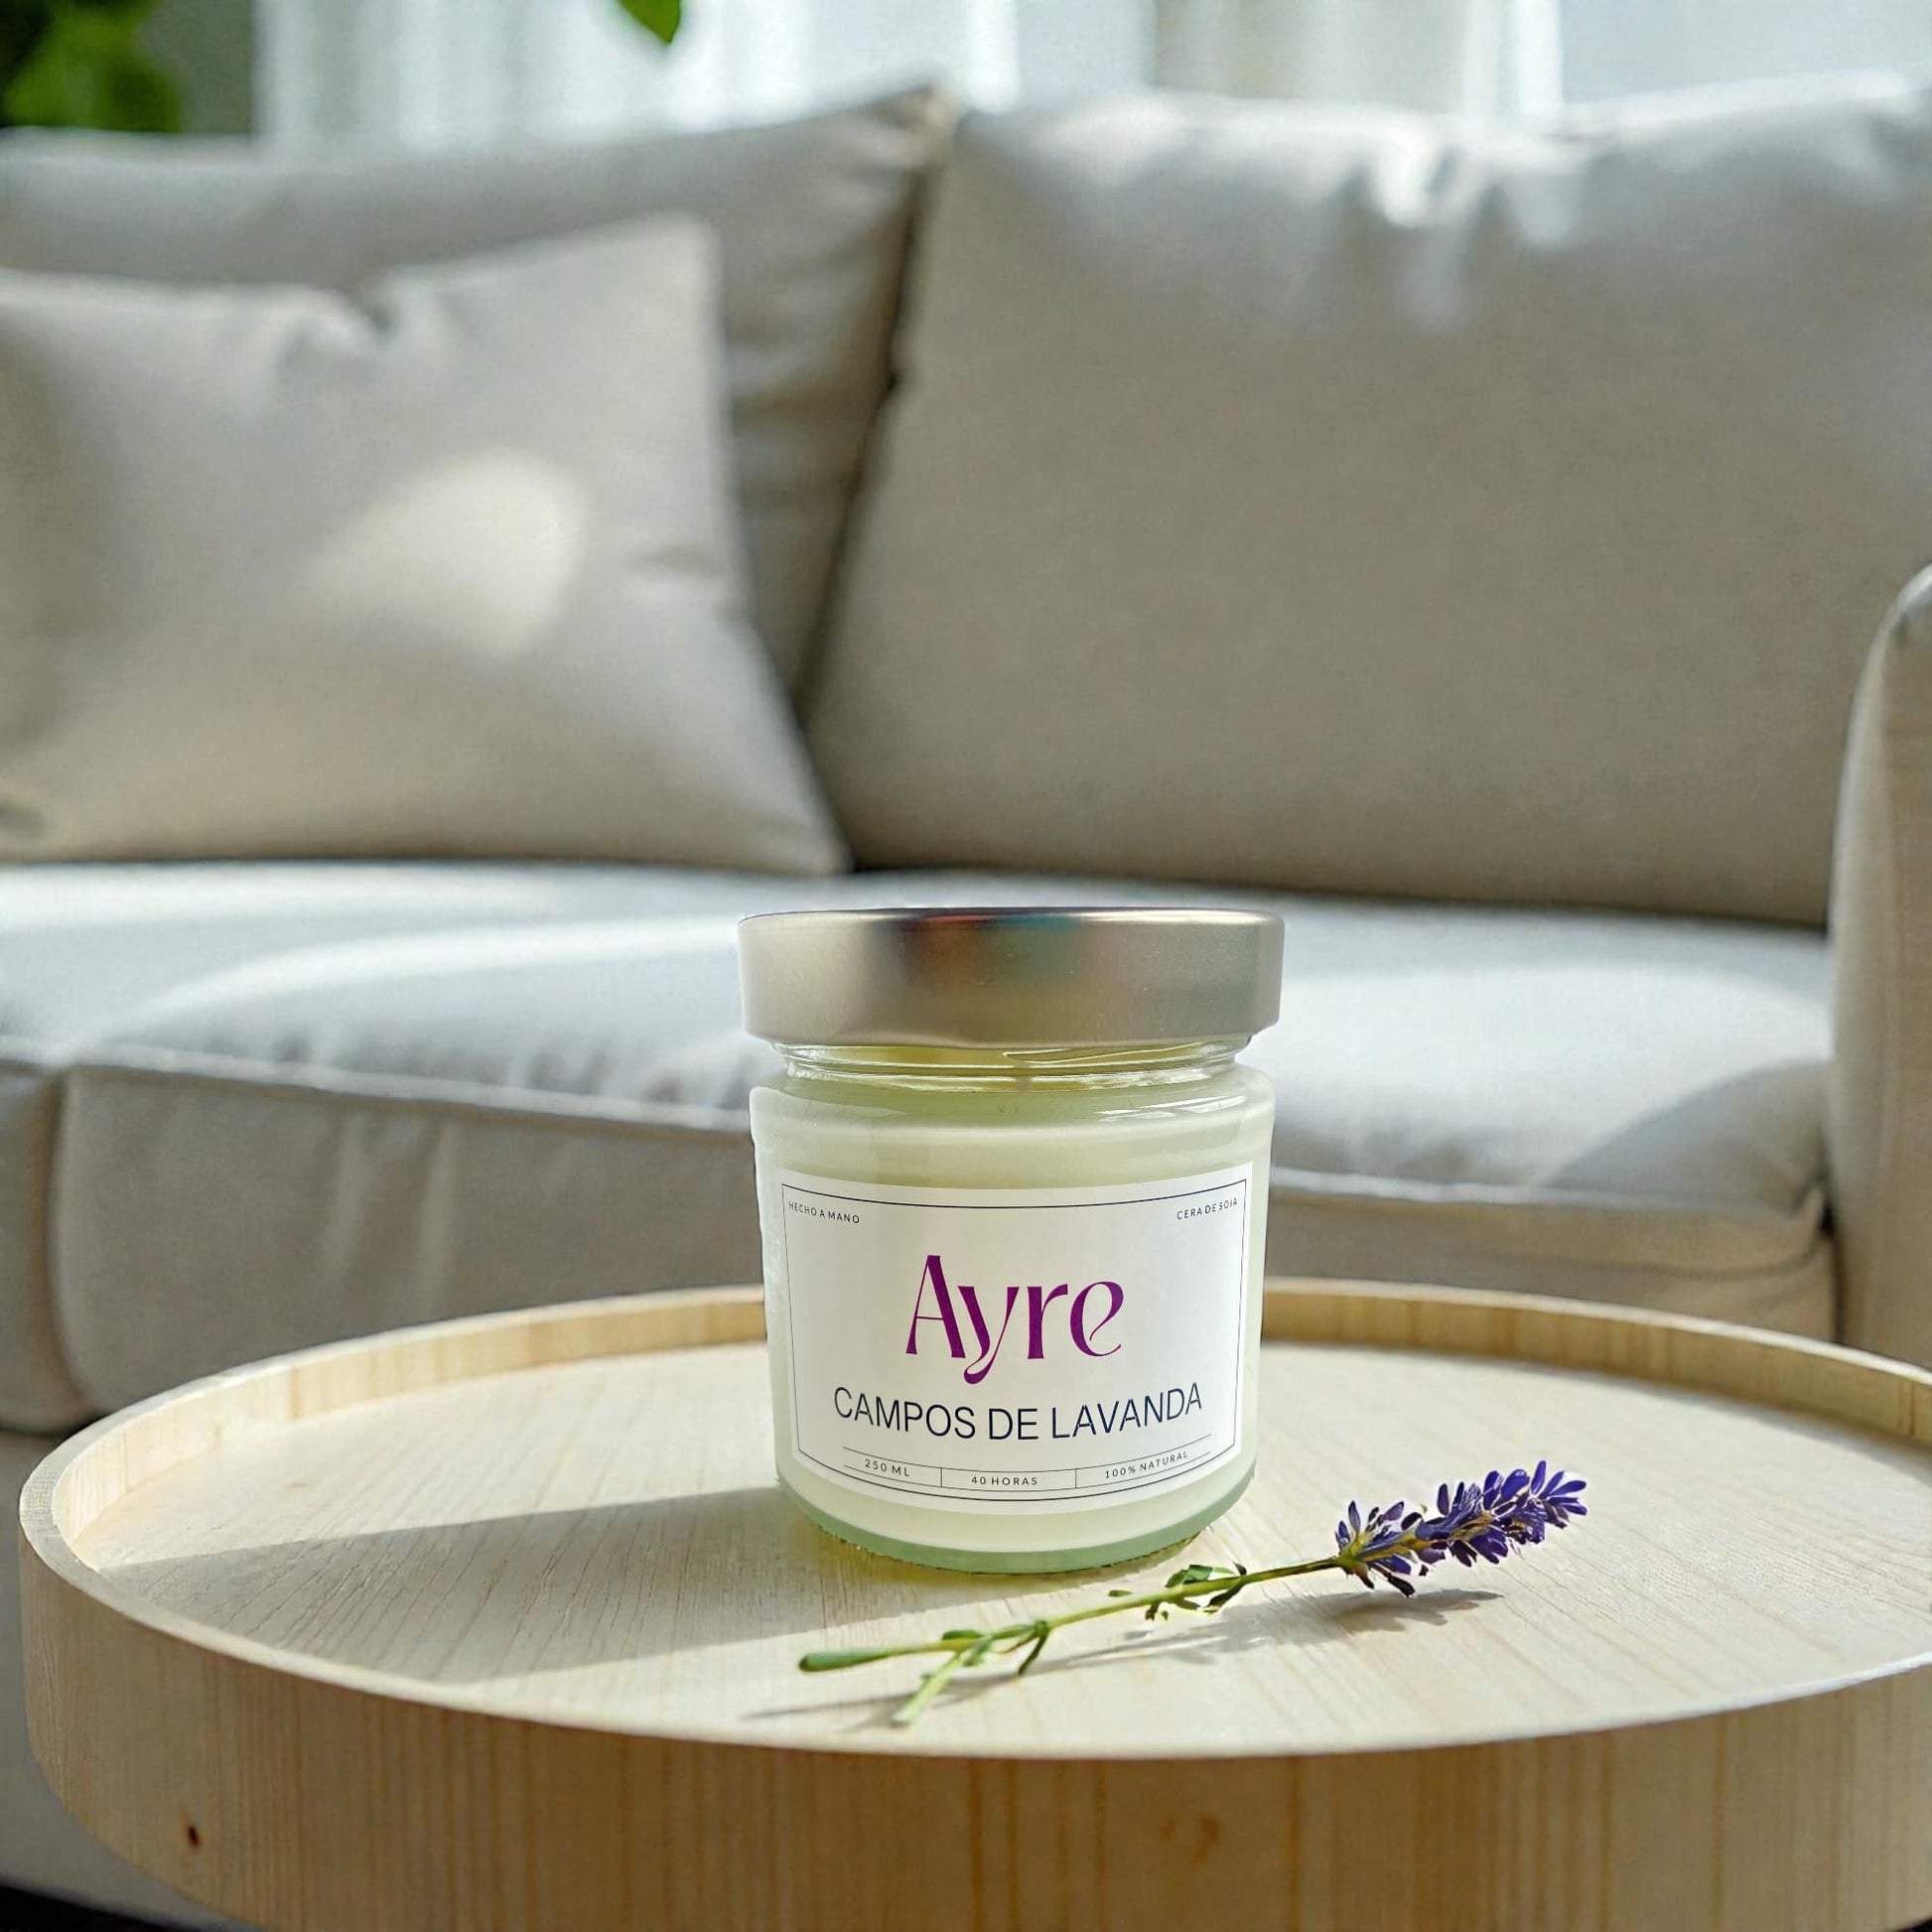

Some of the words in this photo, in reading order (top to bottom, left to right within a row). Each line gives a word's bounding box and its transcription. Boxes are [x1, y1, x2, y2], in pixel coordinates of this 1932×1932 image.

[788, 1200, 817, 1216] HECHO
[819, 1209, 826, 1218] A
[828, 1210, 860, 1224] MANO
[1176, 1207, 1203, 1220] CERA
[1204, 1203, 1217, 1214] DE
[905, 1254, 1125, 1385] Ayre
[834, 1386, 976, 1440] CAMPOS
[989, 1408, 1038, 1441] DE
[1051, 1381, 1202, 1440] LAVANDA
[865, 1458, 888, 1472] 250
[892, 1465, 910, 1477] ML
[1104, 1466, 1136, 1479] 100%
[1140, 1450, 1188, 1473] NATURAL
[971, 1475, 987, 1485] 40
[991, 1476, 1038, 1486] HORAS
